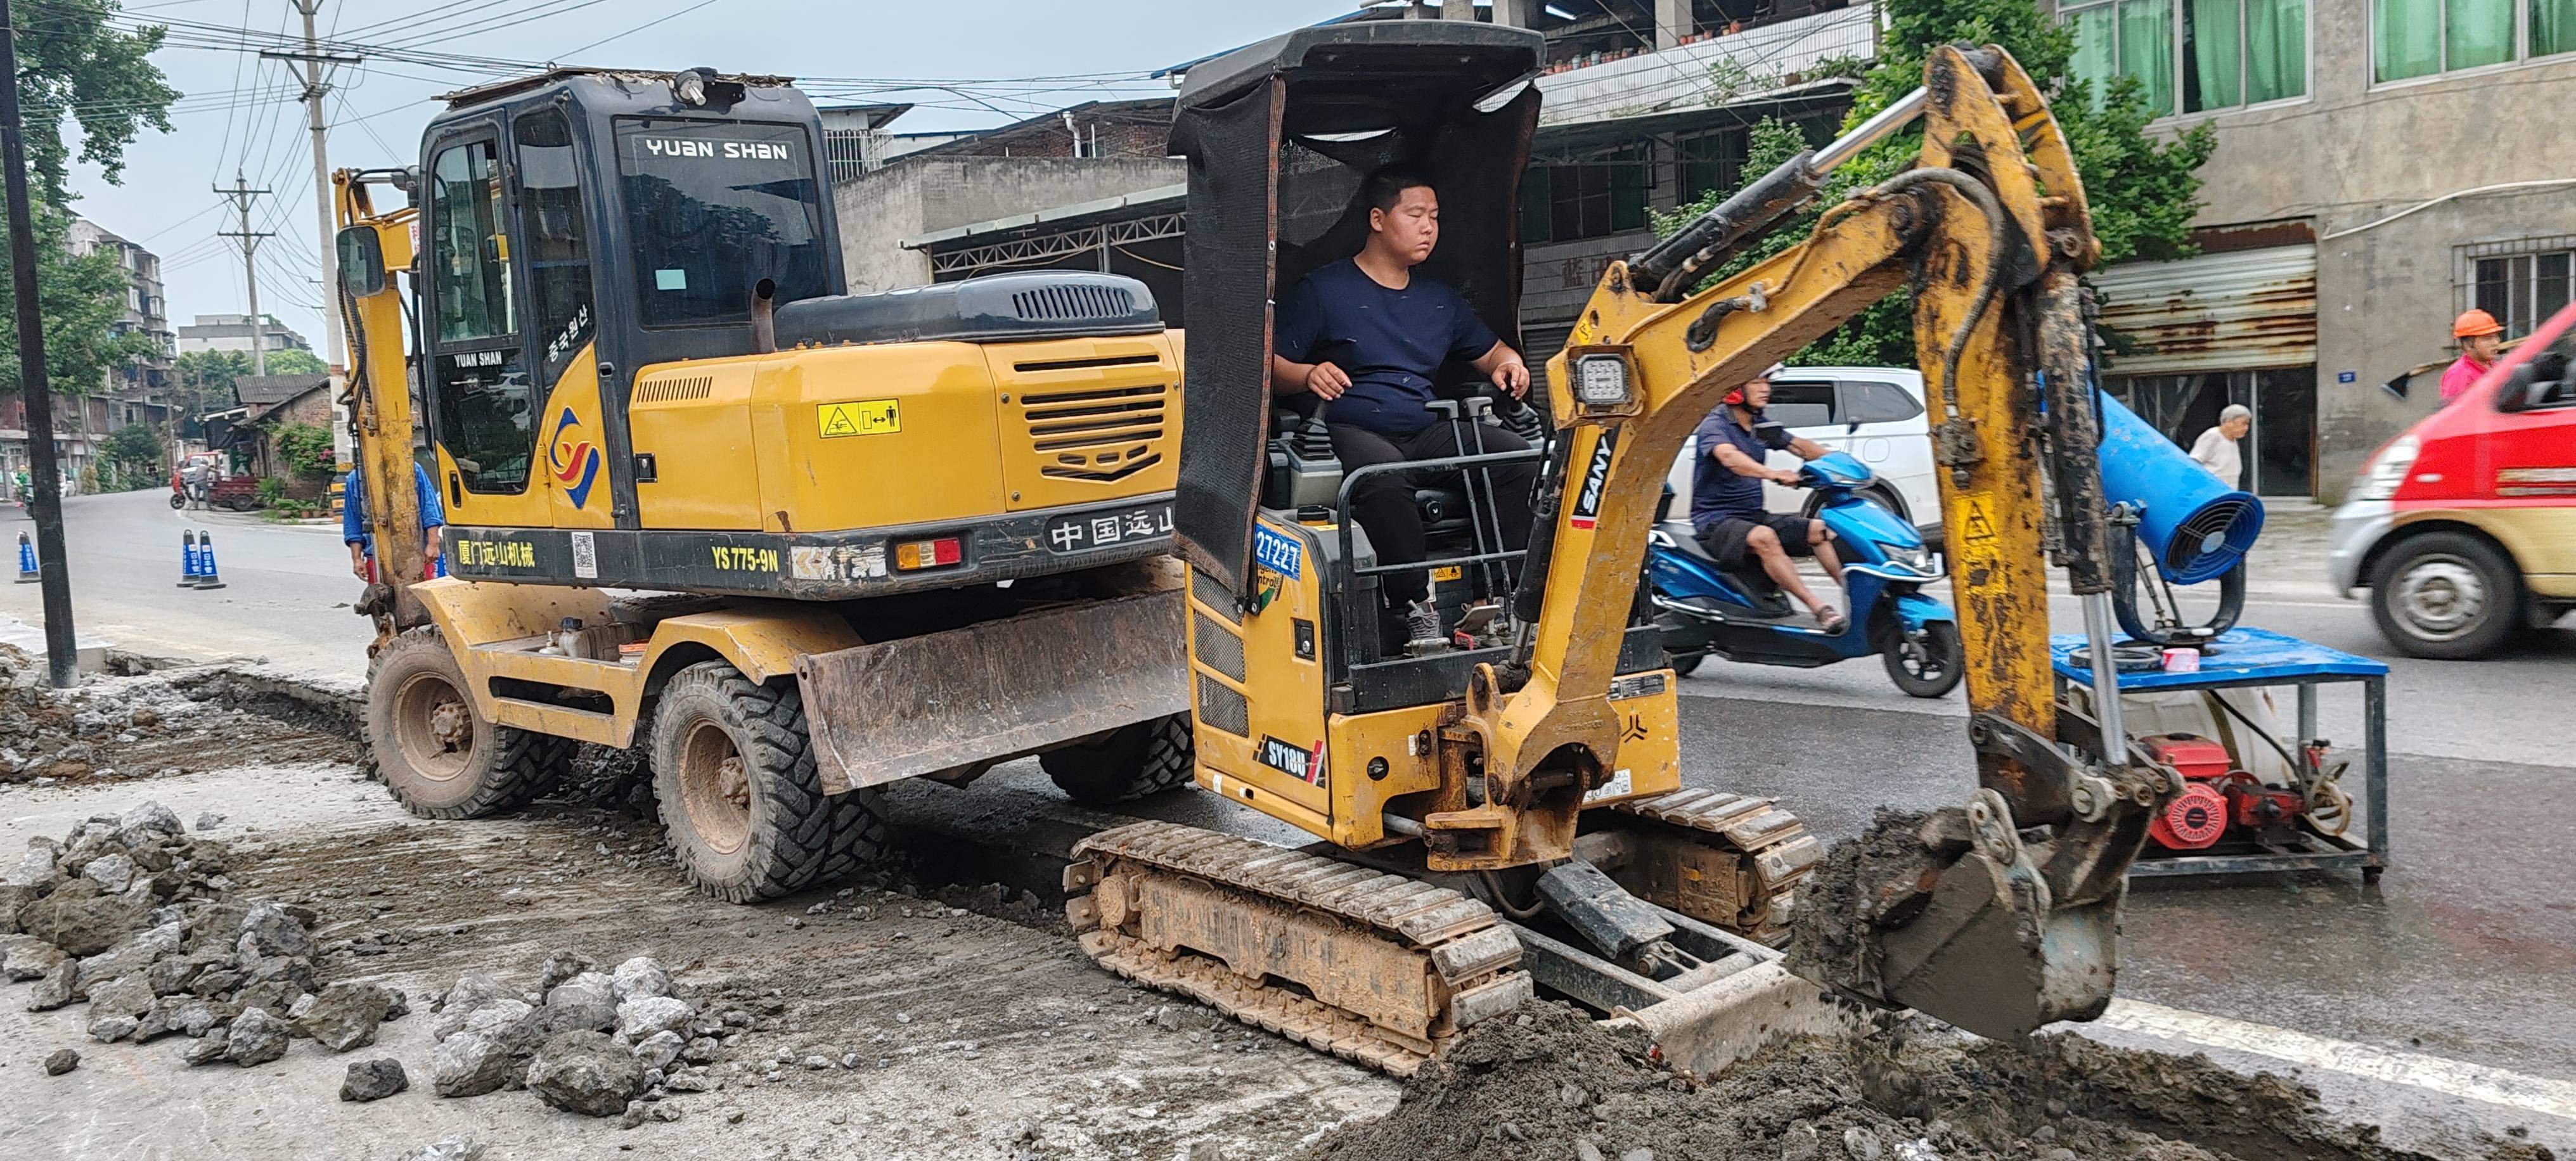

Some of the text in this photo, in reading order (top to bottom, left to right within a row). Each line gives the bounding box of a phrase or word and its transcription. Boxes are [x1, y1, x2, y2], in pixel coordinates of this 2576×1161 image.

[548, 304, 588, 362] 중국원산
[454, 350, 502, 368] YUAN SHAN
[1583, 436, 1612, 514] SANY
[1052, 506, 1175, 551] 中国远山
[458, 540, 535, 567] 厦门远山机械
[711, 546, 779, 572] YS 775-9N
[1257, 531, 1298, 572] 27227
[1268, 740, 1306, 777] SY18U
